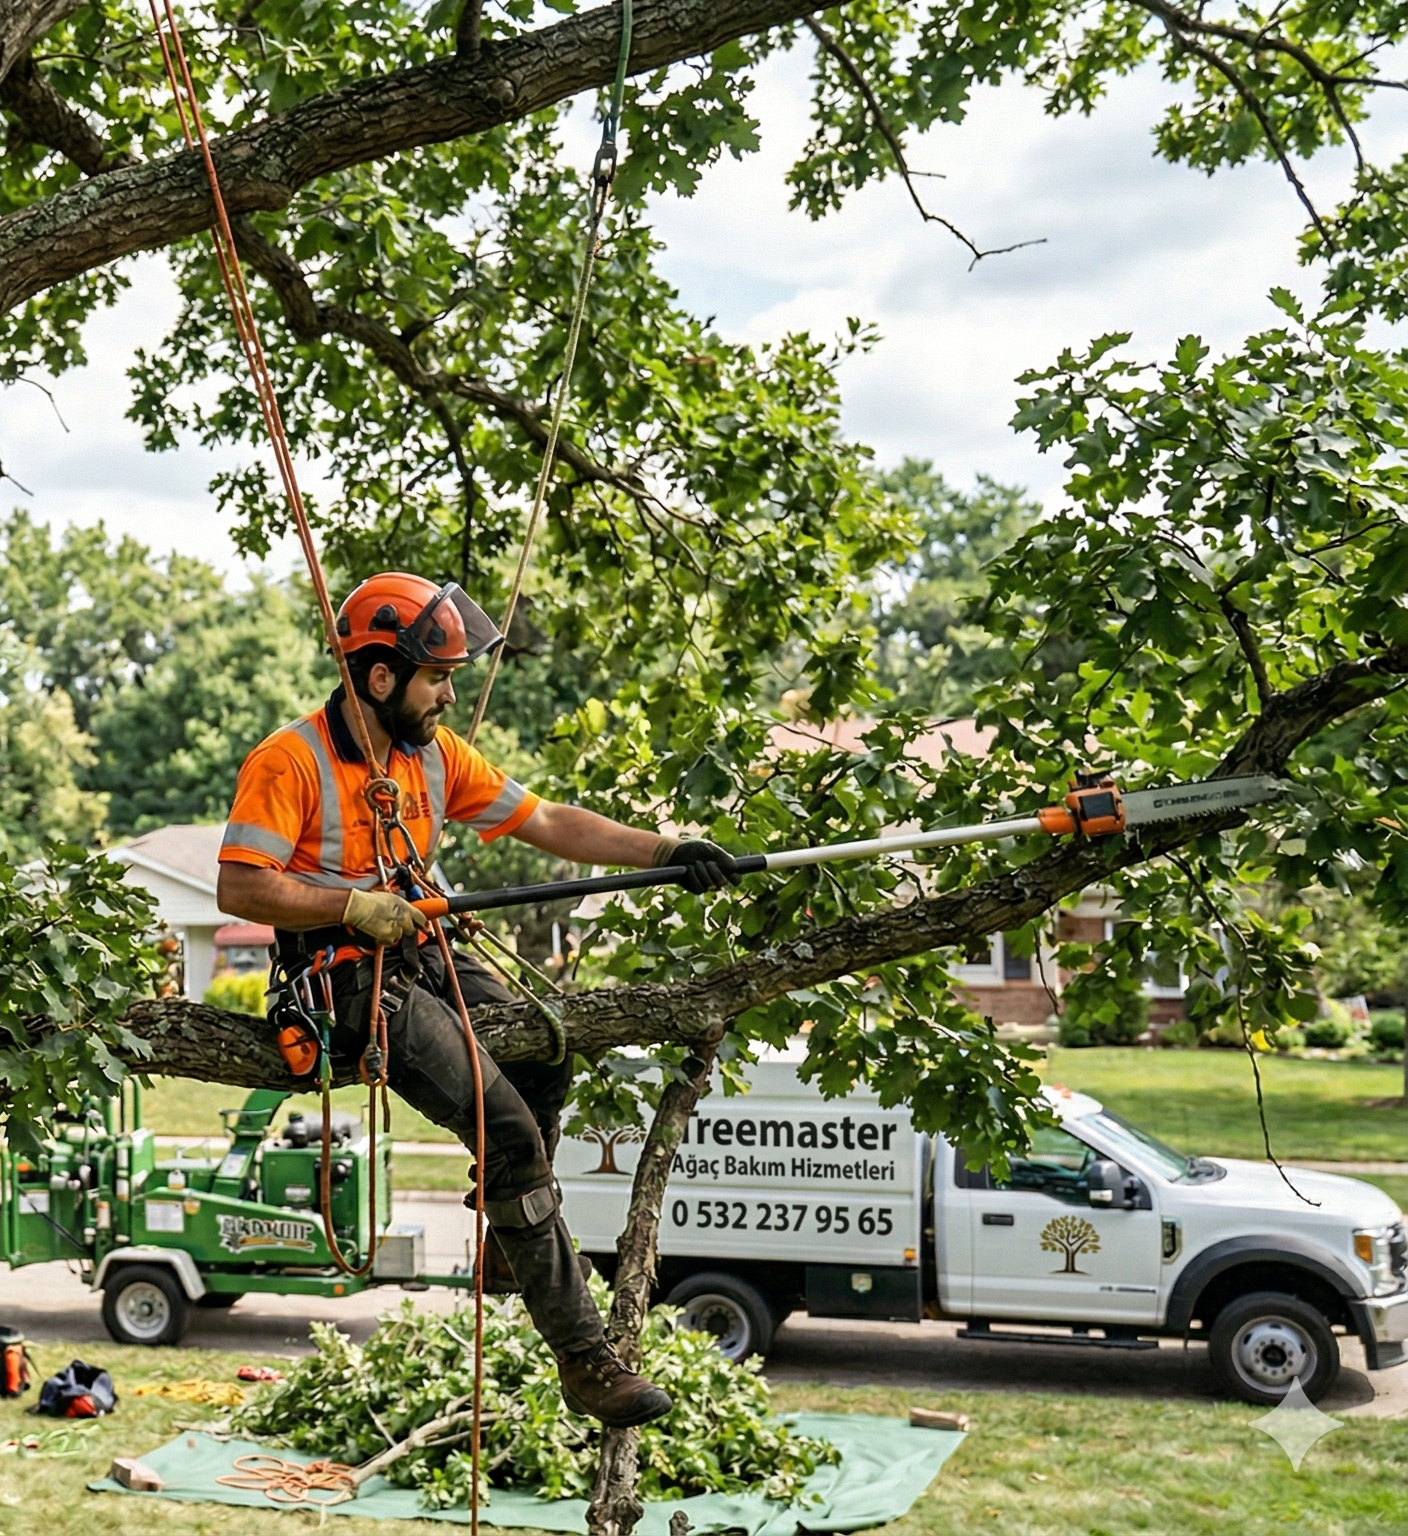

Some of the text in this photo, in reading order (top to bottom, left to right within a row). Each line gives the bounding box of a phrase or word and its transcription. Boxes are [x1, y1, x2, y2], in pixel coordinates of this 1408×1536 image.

[672, 1154, 895, 1181] Ağaç Bakım Hizmetleri
[672, 1200, 893, 1236] 0 532 237 95 65
